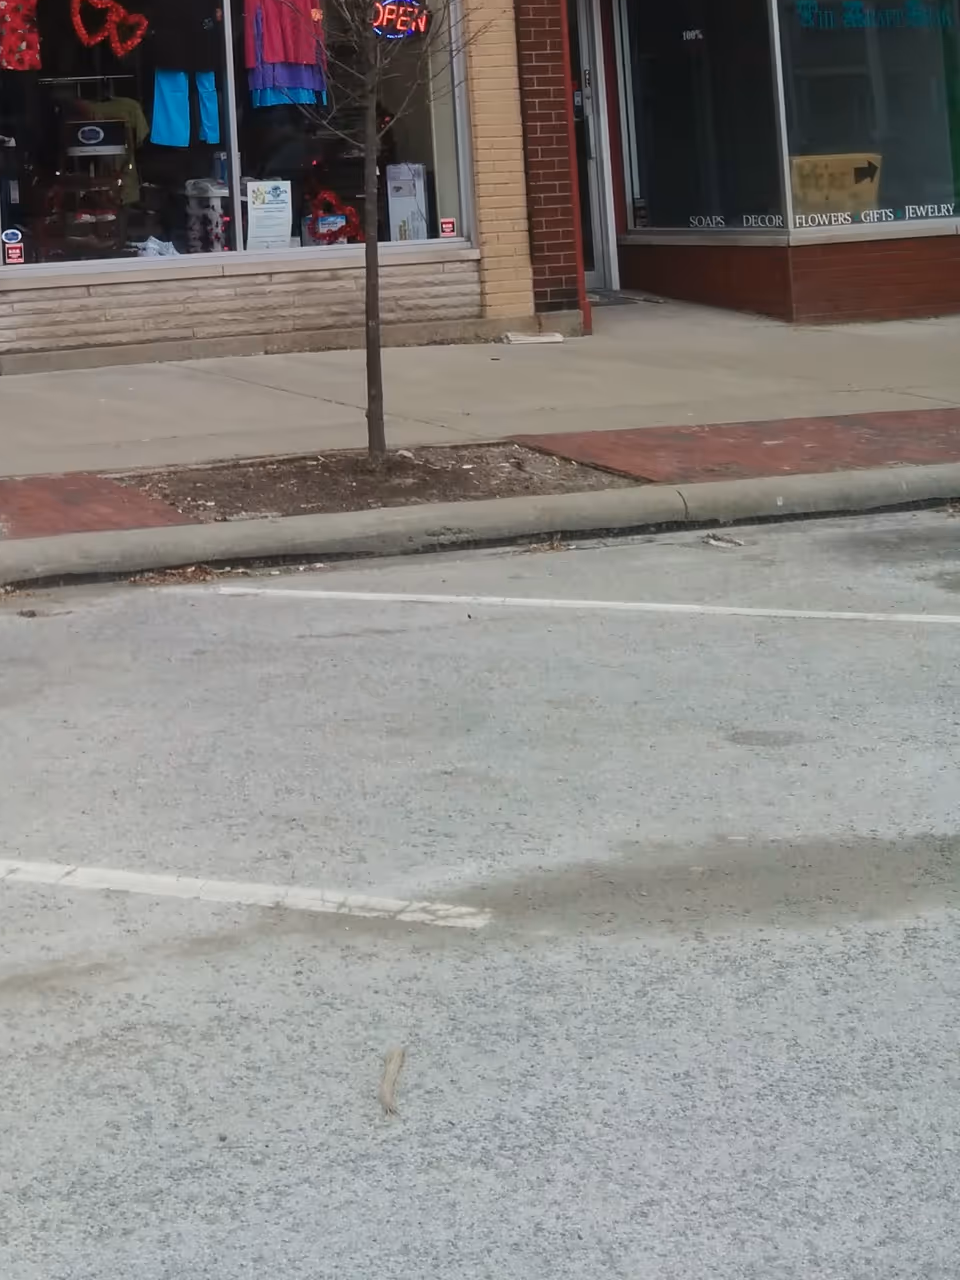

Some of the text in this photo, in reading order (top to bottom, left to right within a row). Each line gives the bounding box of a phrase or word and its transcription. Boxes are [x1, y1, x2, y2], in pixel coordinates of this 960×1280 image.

[690, 203, 955, 228] SOAPS DECOR FLOWERS GIFTS JEWELRY
